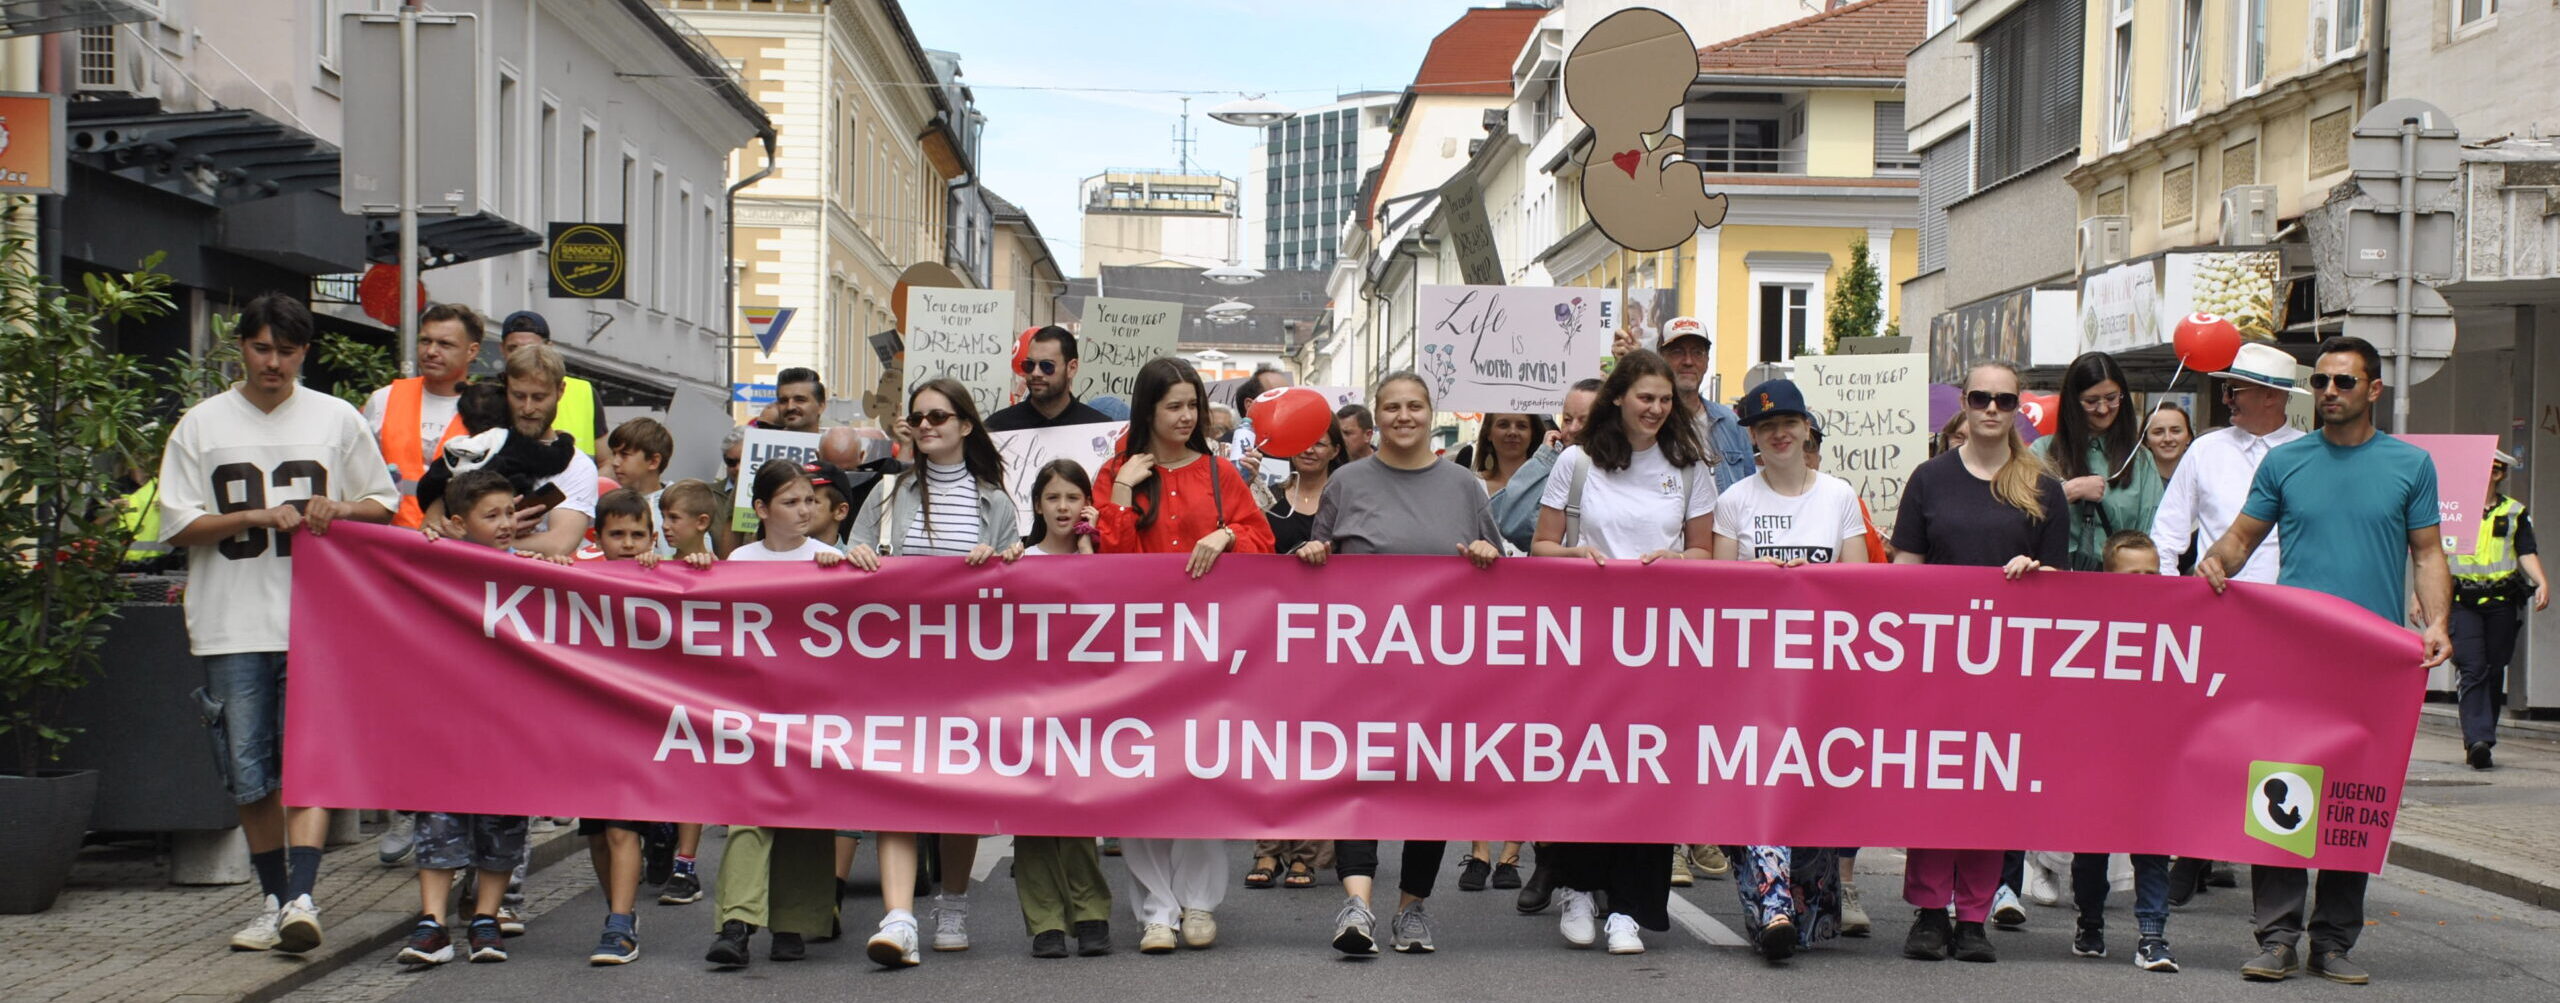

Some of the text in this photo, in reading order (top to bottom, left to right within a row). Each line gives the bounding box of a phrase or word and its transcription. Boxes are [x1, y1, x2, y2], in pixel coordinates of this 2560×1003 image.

[923, 294, 947, 312] You
[1098, 303, 1119, 323] You
[1435, 290, 1508, 363] Life
[912, 326, 1002, 356] DREAMS
[935, 360, 990, 382] YOUR
[1473, 358, 1513, 380] worth
[1813, 364, 1844, 387] You
[1102, 372, 1135, 396] YOU
[1832, 444, 1902, 472] YOUR
[1754, 515, 1793, 530] RETTET
[1754, 530, 1774, 545] DIE
[1757, 548, 1808, 562] KLEINEN
[483, 582, 2226, 697] KINDER SCHÜTZEN, FRAUEN UNTERSTÜTZEN,
[653, 704, 2042, 793] ABTREIBUNG UNDENKBAR MACHEN.
[2329, 781, 2386, 803] JUGEND
[2326, 801, 2389, 828] FÜR DAS
[2324, 829, 2368, 848] LEBEN
